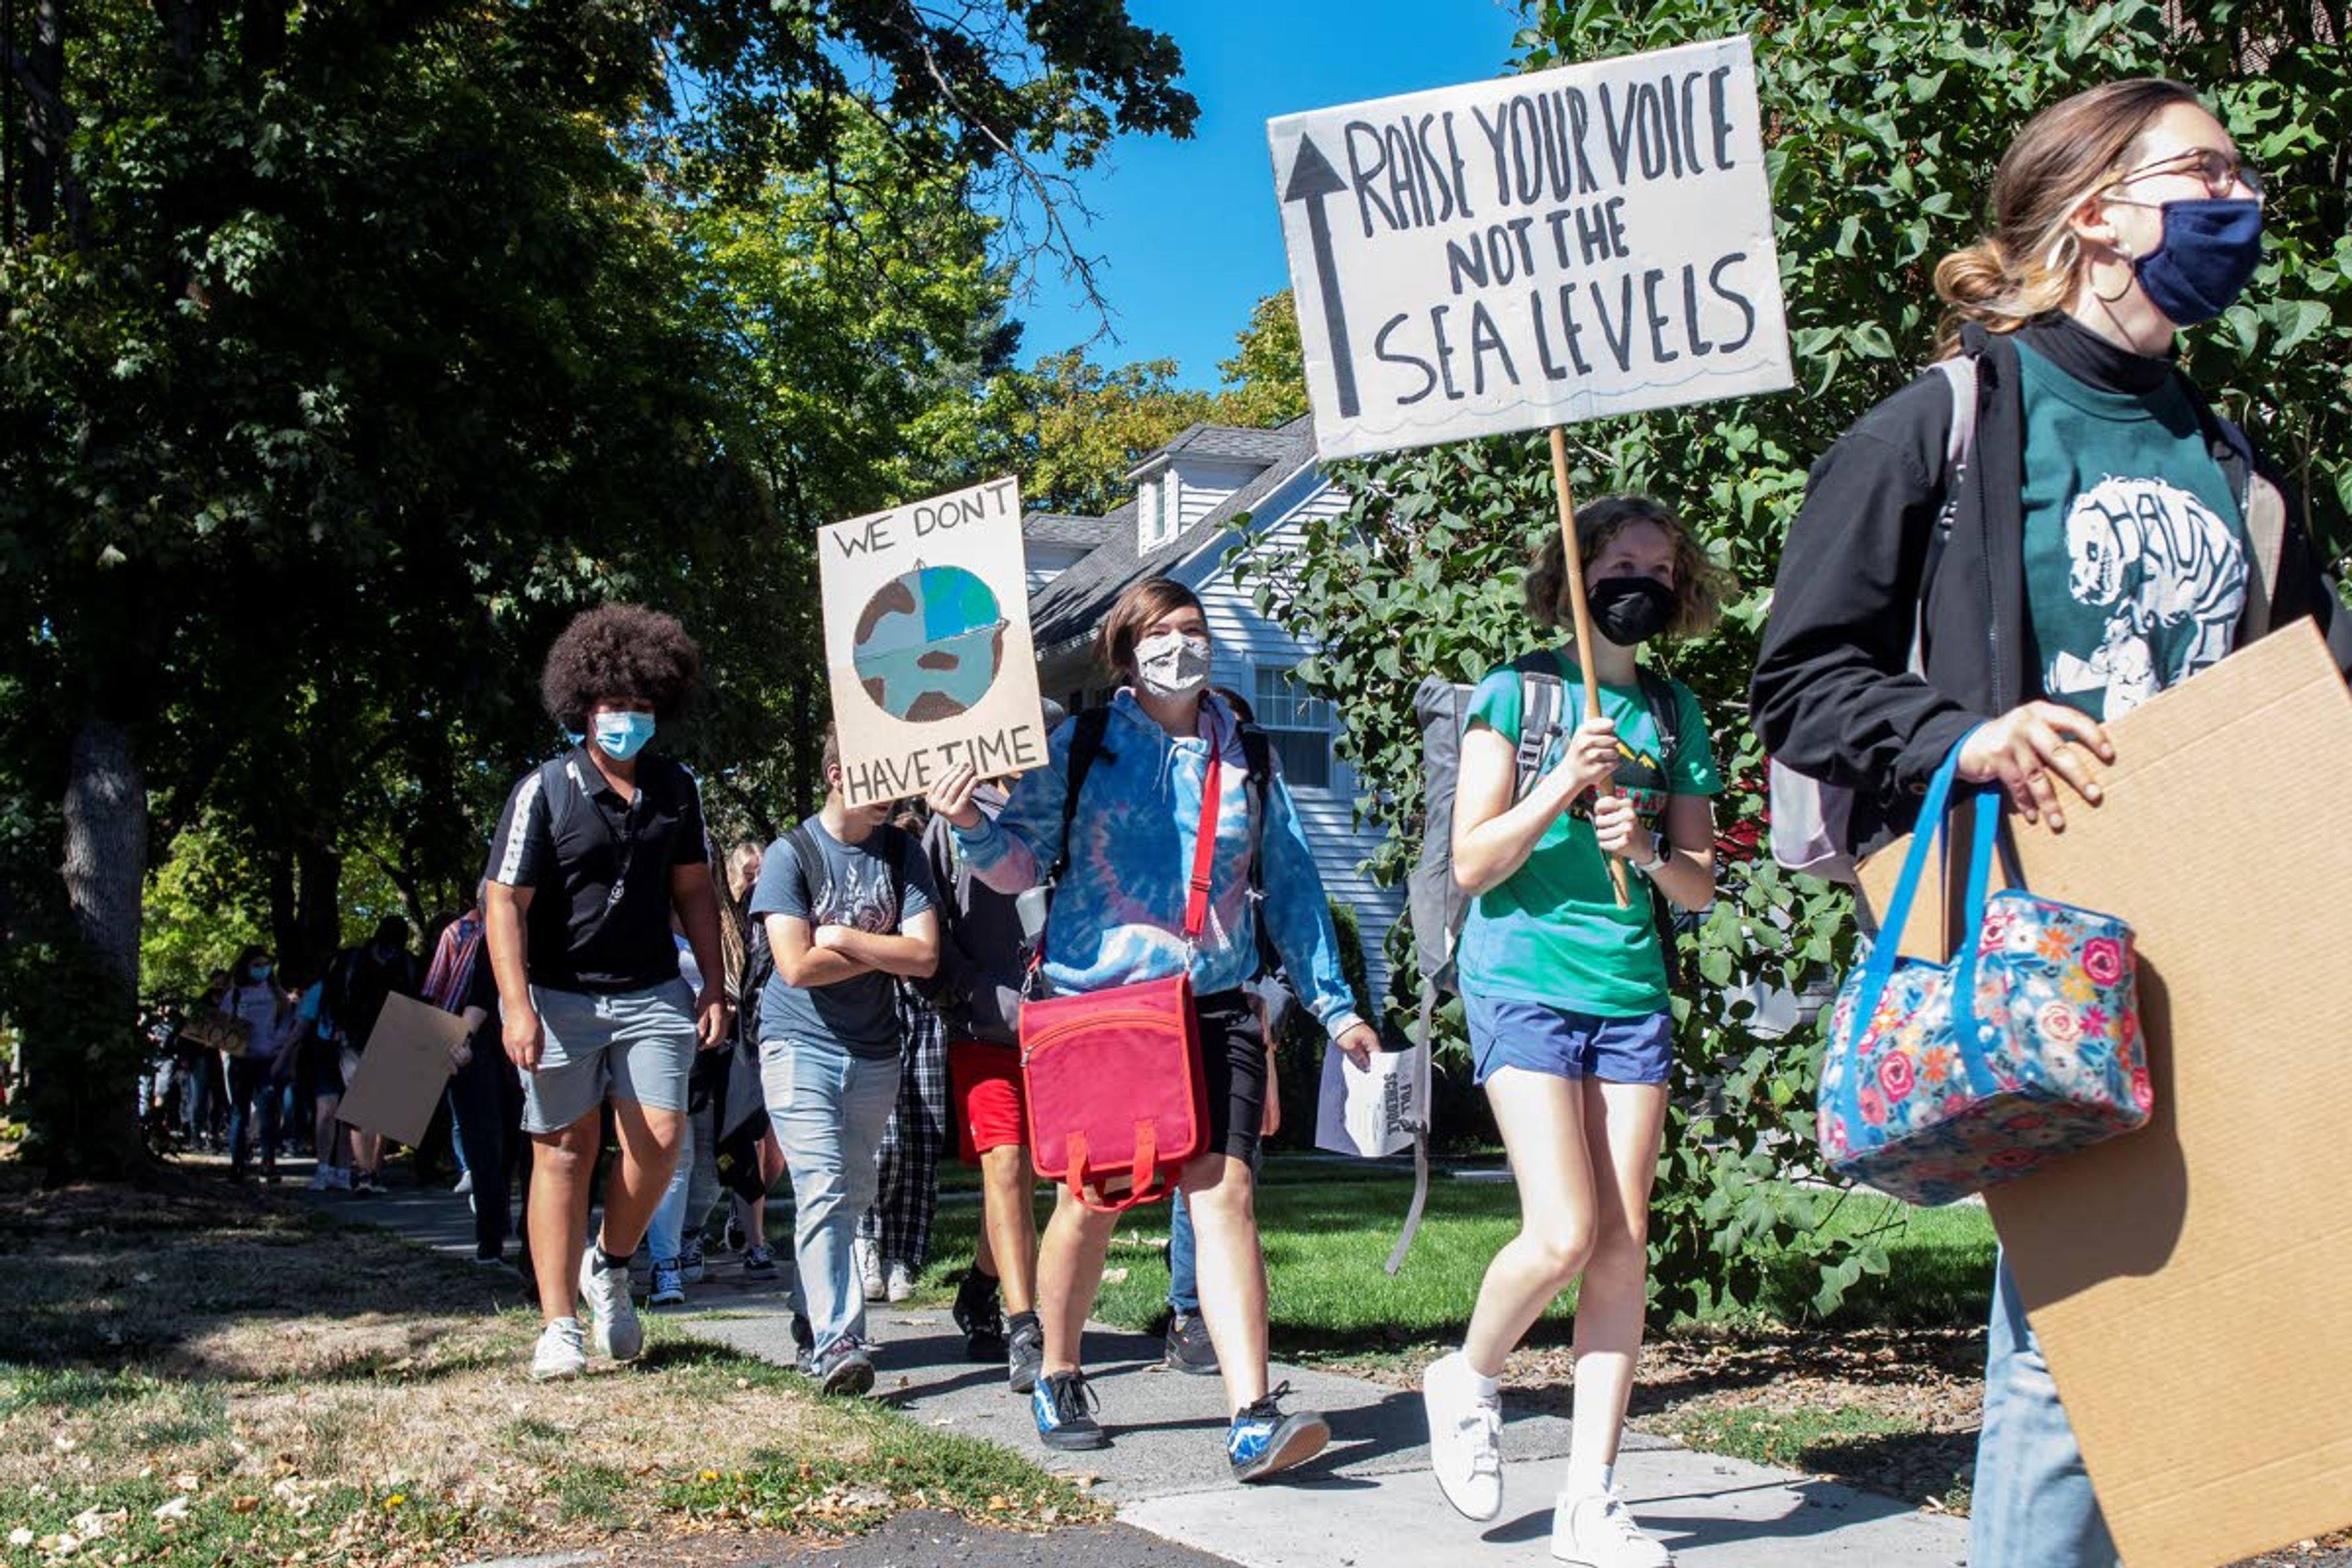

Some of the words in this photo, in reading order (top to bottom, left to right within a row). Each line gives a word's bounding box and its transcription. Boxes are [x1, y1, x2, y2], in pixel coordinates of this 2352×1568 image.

[1344, 111, 1474, 238] RAISE
[1471, 86, 1599, 206] YOUR
[1598, 66, 1735, 185] VOICE
[1446, 217, 1532, 295] NOT
[1546, 197, 1629, 268] THE
[1374, 300, 1520, 405] SEA
[1530, 252, 1756, 381] LEVELS
[833, 514, 894, 558] WE
[846, 748, 930, 804] HAVE
[937, 725, 1037, 775] TIME
